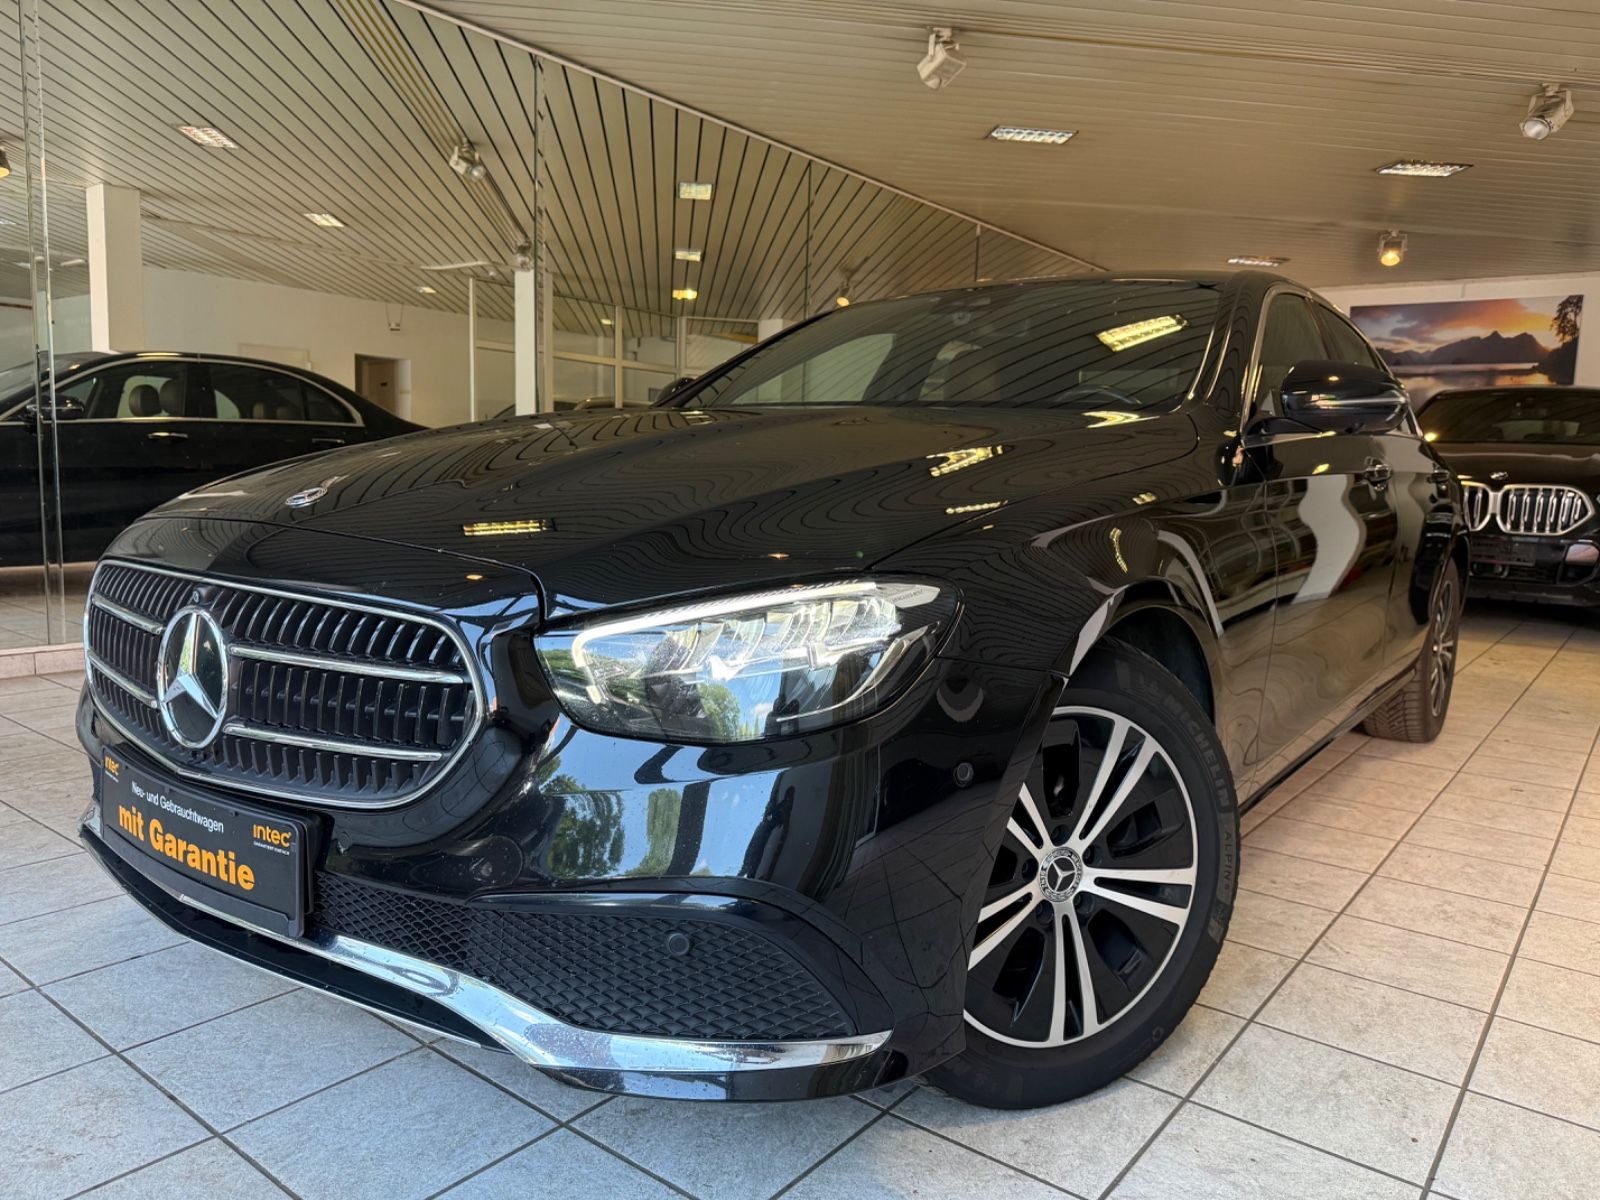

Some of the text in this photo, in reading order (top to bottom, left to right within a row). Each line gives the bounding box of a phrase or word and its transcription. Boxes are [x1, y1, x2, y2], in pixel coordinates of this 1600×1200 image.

[1164, 694, 1231, 809] MICHELIN
[131, 780, 224, 834] Neu- und Gebrauchtwagen
[118, 803, 255, 891] mit Garantie
[252, 823, 291, 848] intec
[1223, 831, 1234, 881] ALPIN
